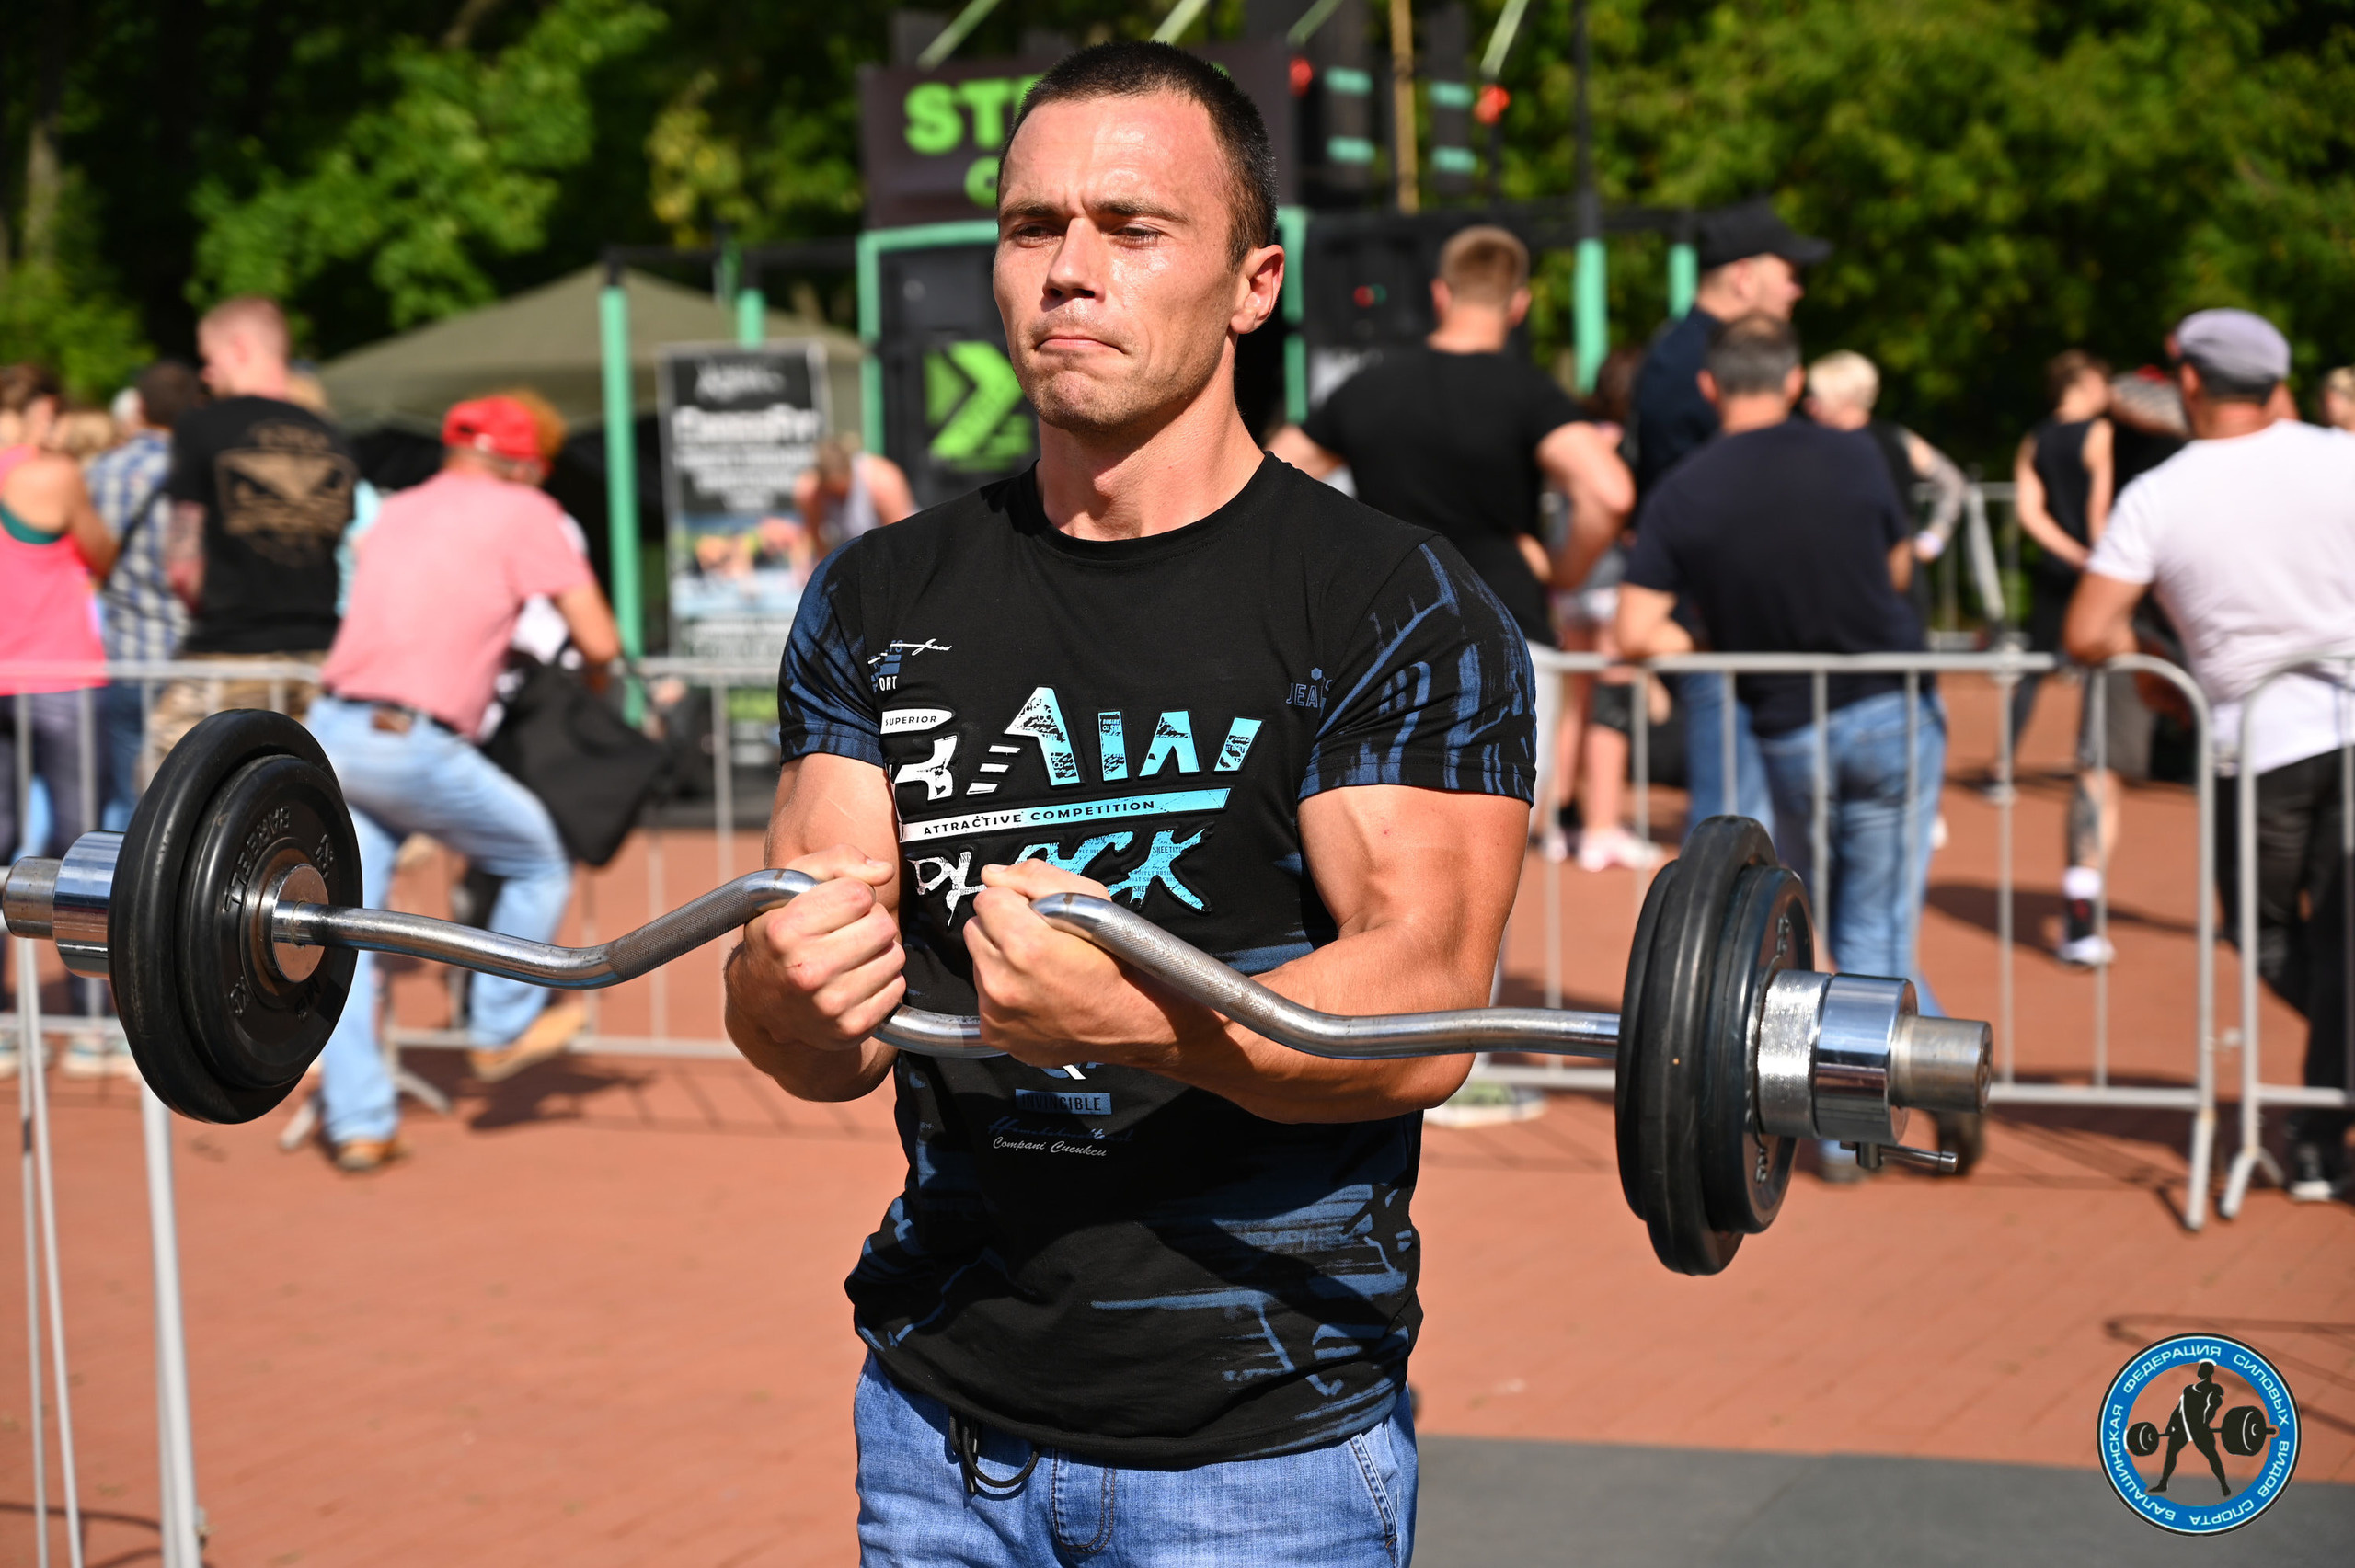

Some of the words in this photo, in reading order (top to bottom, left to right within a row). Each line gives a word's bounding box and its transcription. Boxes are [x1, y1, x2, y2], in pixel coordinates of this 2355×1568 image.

[885, 715, 937, 727] SUPERIOR
[924, 813, 1022, 835] ATTRACTIVE
[1030, 800, 1155, 822] COMPETITION
[1021, 1093, 1102, 1112] INVINCIBLE
[993, 1136, 1047, 1151] Compani
